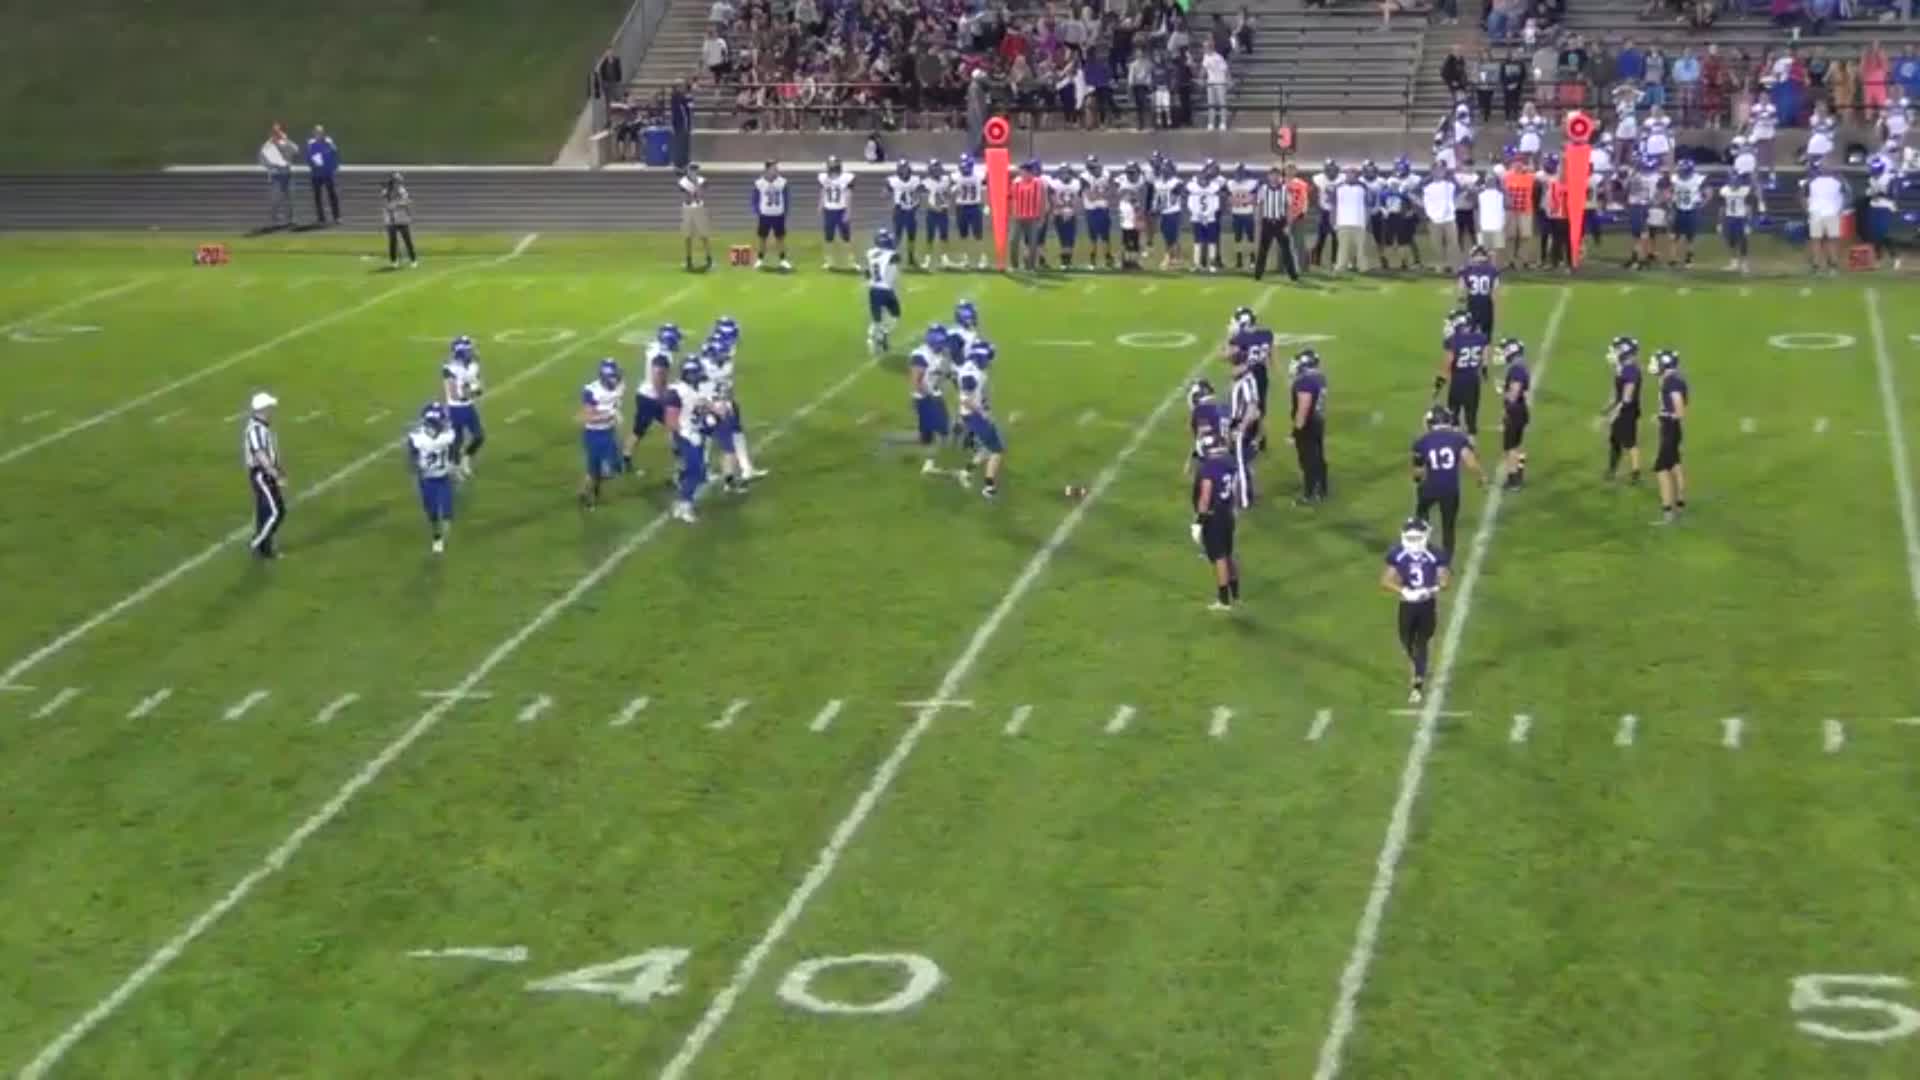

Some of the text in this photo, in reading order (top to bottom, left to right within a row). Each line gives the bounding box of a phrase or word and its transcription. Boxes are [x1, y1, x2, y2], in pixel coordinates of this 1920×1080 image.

[1468, 274, 1491, 297] 30
[1456, 346, 1482, 368] 25
[1428, 446, 1455, 471] 13
[1409, 565, 1425, 588] 3
[1788, 973, 1920, 1041] 5
